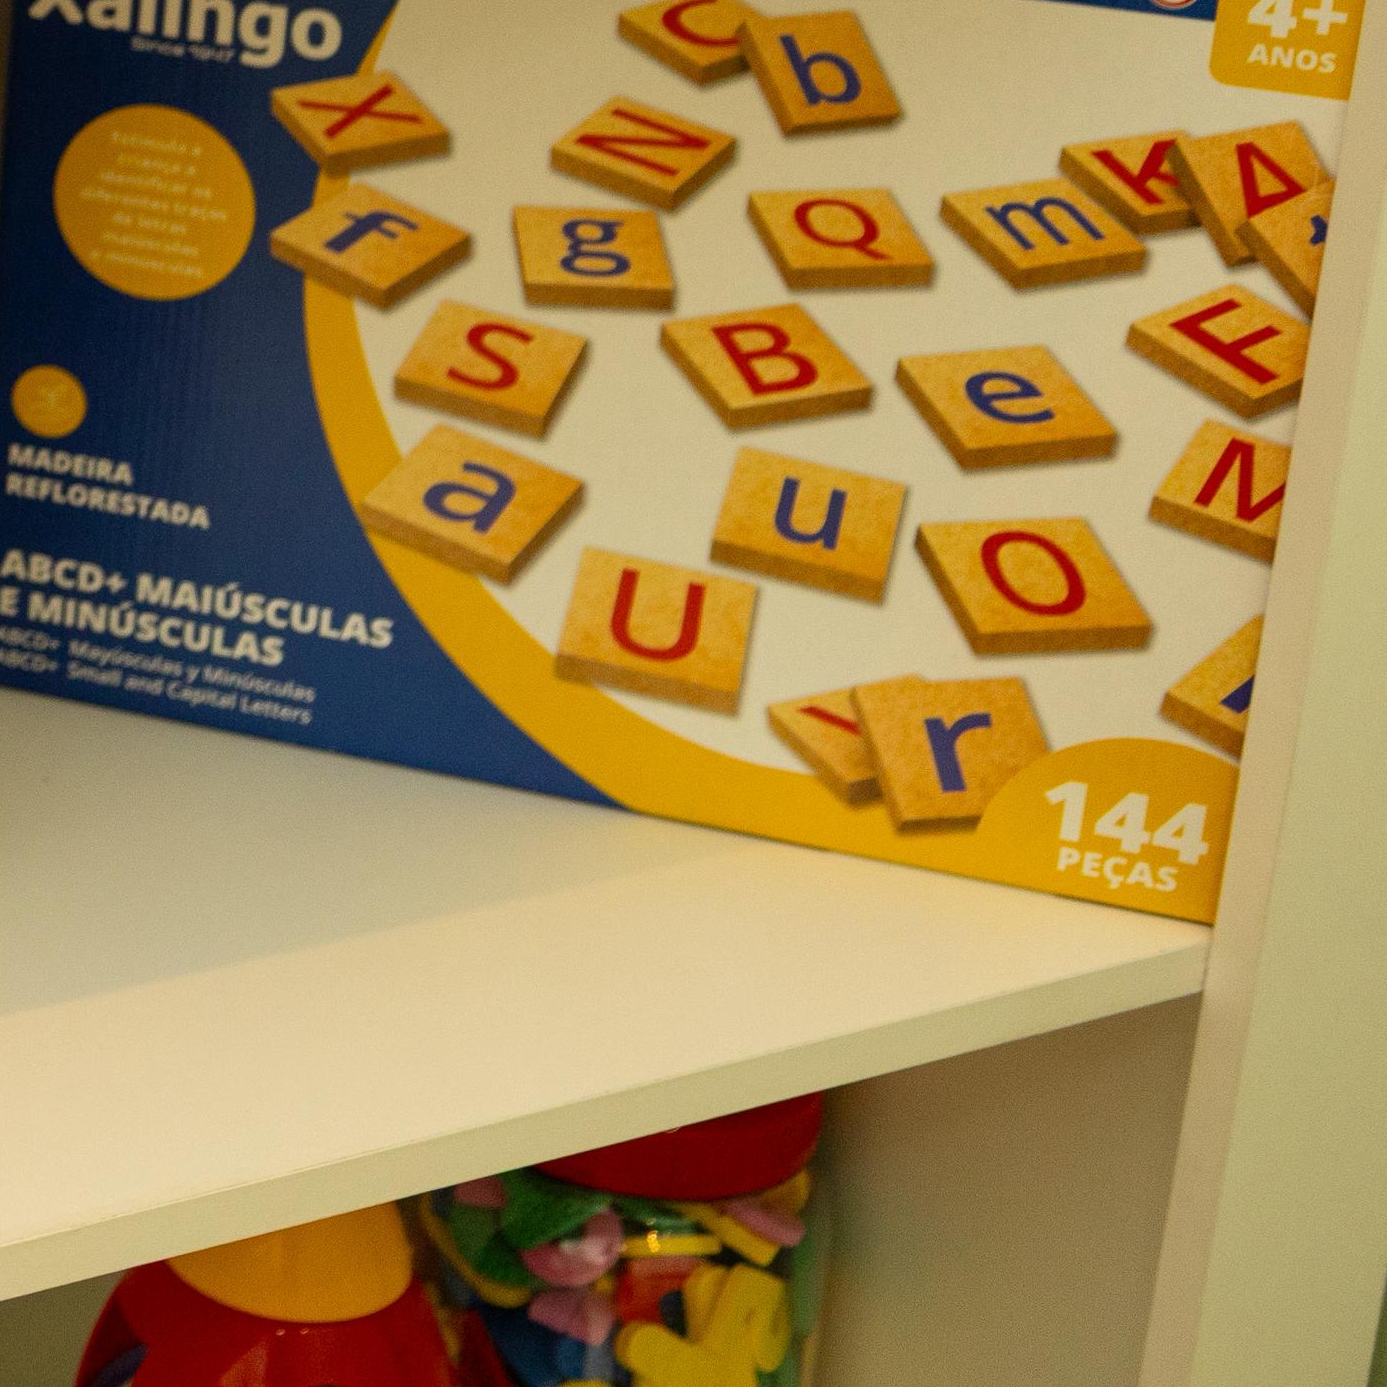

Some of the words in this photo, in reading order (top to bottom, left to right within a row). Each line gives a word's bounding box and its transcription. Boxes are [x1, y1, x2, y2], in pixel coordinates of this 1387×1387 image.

[779, 34, 862, 106] b
[1246, 42, 1339, 75] ANOS
[560, 218, 632, 277] g
[794, 198, 891, 261] Q
[984, 196, 1107, 252] m
[446, 322, 534, 392] S
[711, 322, 819, 397] B
[964, 369, 1056, 425] e
[7, 443, 133, 486] MADEIRA
[422, 458, 517, 534] a
[5, 475, 212, 530] REFLORESTADA
[773, 477, 847, 553] u
[979, 528, 1085, 616] O
[29, 589, 286, 667] MINÚSCULAS
[135, 569, 395, 650] MAIÚSCULAS
[609, 566, 707, 664] U
[924, 713, 992, 792] r
[1045, 781, 1209, 865] 144
[1057, 846, 1178, 892] PEÇAS
